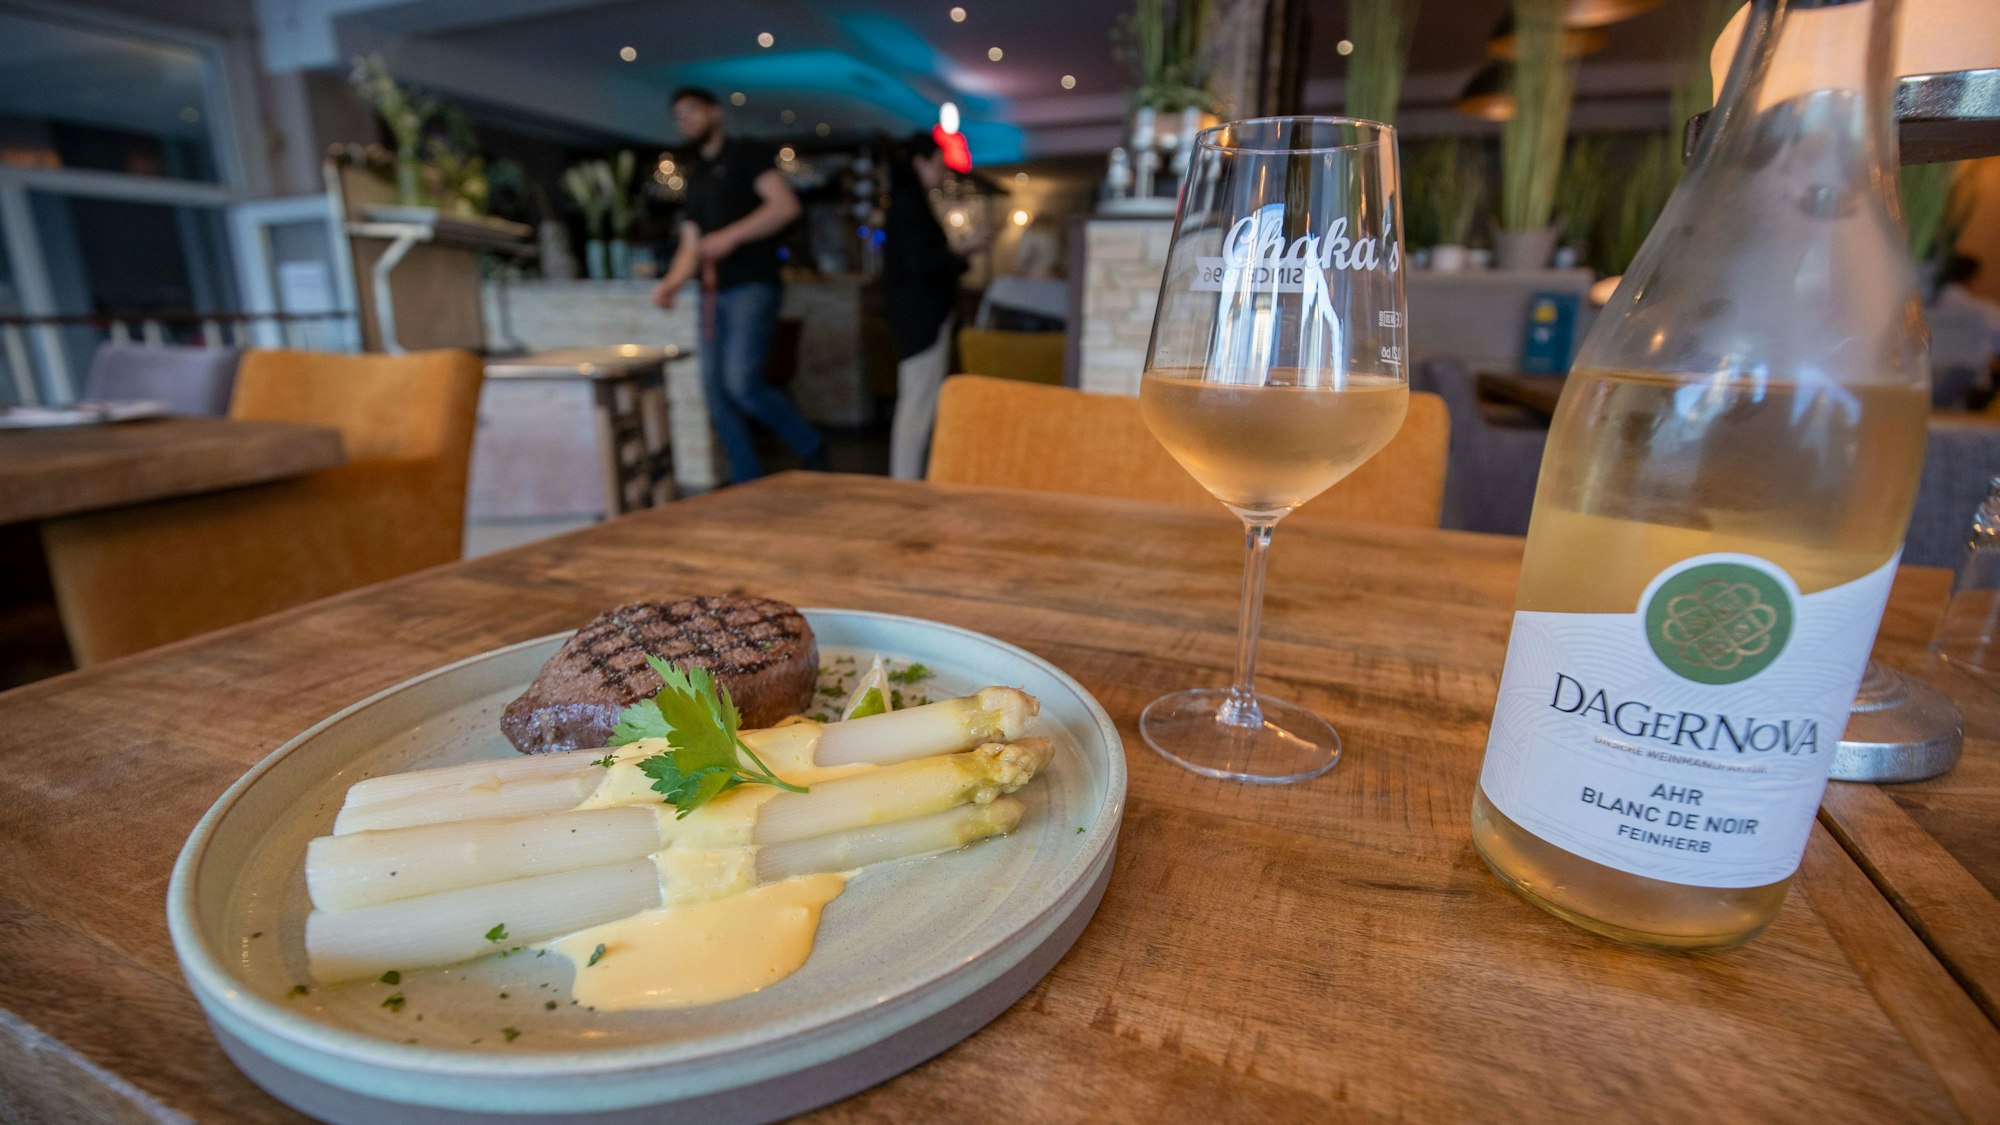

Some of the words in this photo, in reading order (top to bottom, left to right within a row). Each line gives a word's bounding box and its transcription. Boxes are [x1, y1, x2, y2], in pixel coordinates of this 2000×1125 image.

[1222, 216, 1400, 273] Chaka's
[1581, 786, 1661, 822] BLANC
[1666, 810, 1701, 831] DE
[1704, 816, 1760, 836] NOIR
[1650, 783, 1704, 806] AHR
[1617, 824, 1712, 853] FEINHERB
